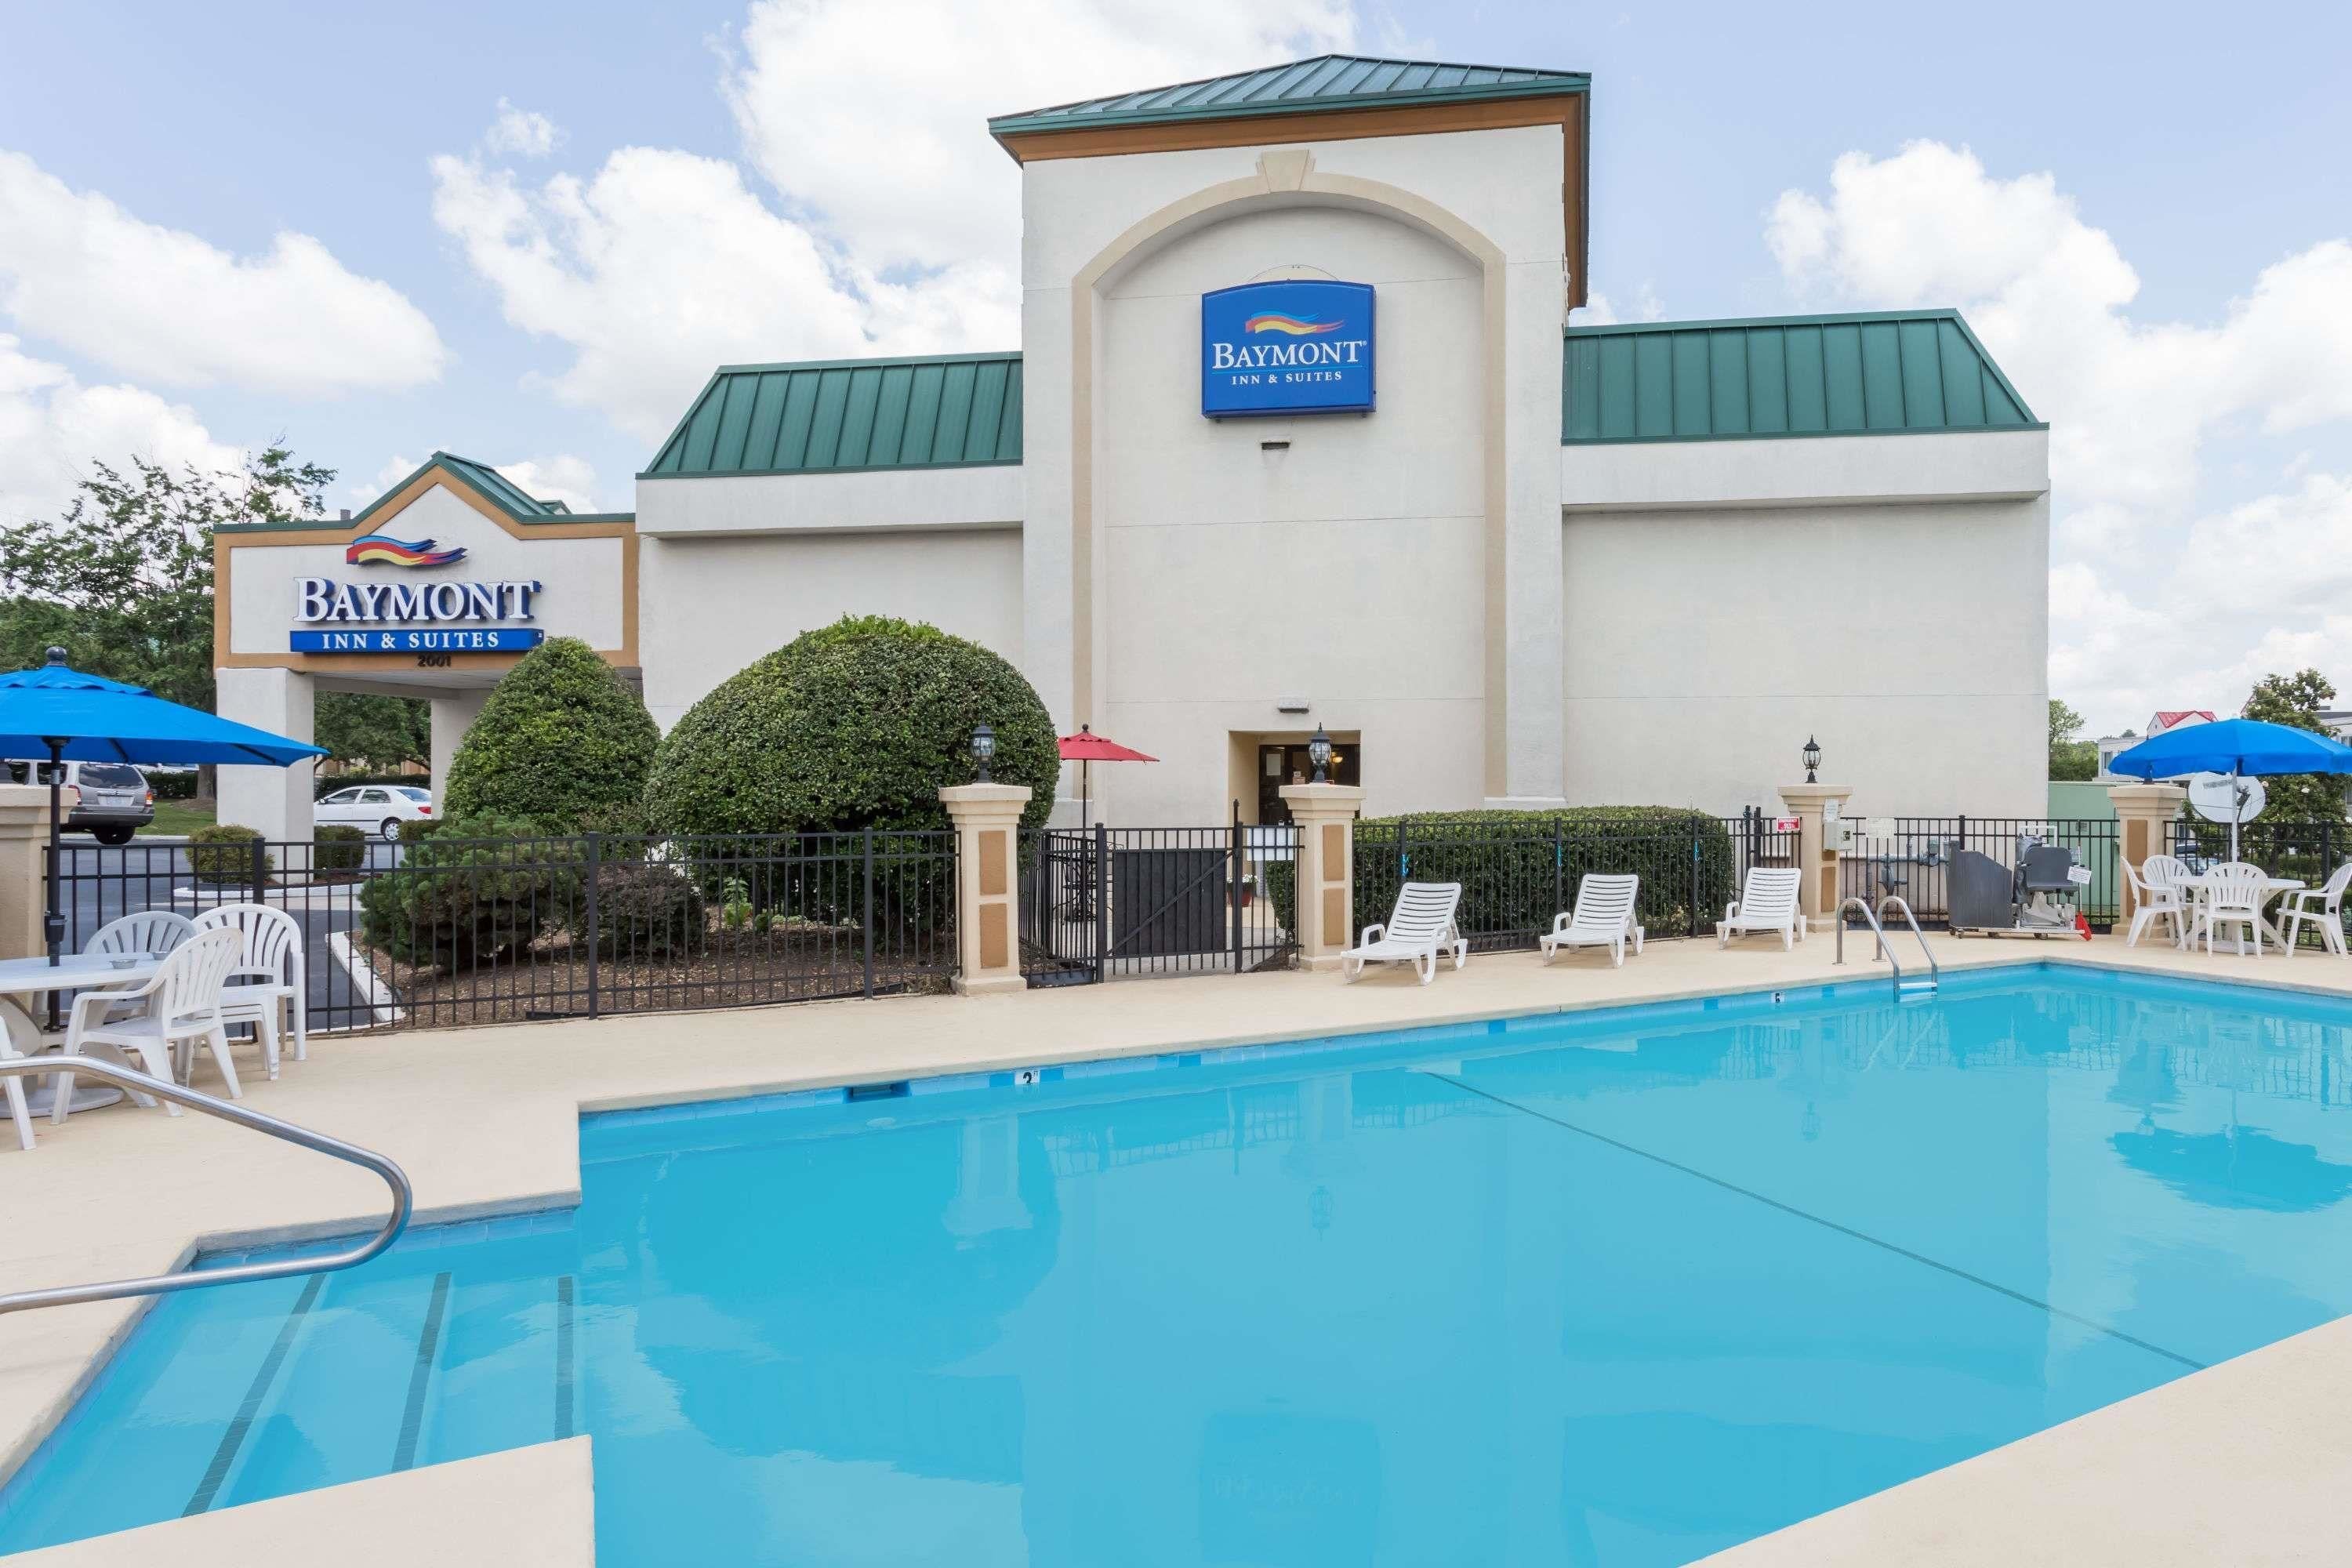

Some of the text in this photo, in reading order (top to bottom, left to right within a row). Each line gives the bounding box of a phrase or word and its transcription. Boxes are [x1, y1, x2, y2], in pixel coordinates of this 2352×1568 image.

[1212, 340, 1363, 368] BAYMONT
[1232, 371, 1342, 385] INN & SUITES
[293, 577, 541, 621] BAYMONT
[322, 632, 499, 649] INN & SUITES
[417, 653, 452, 667] 2001
